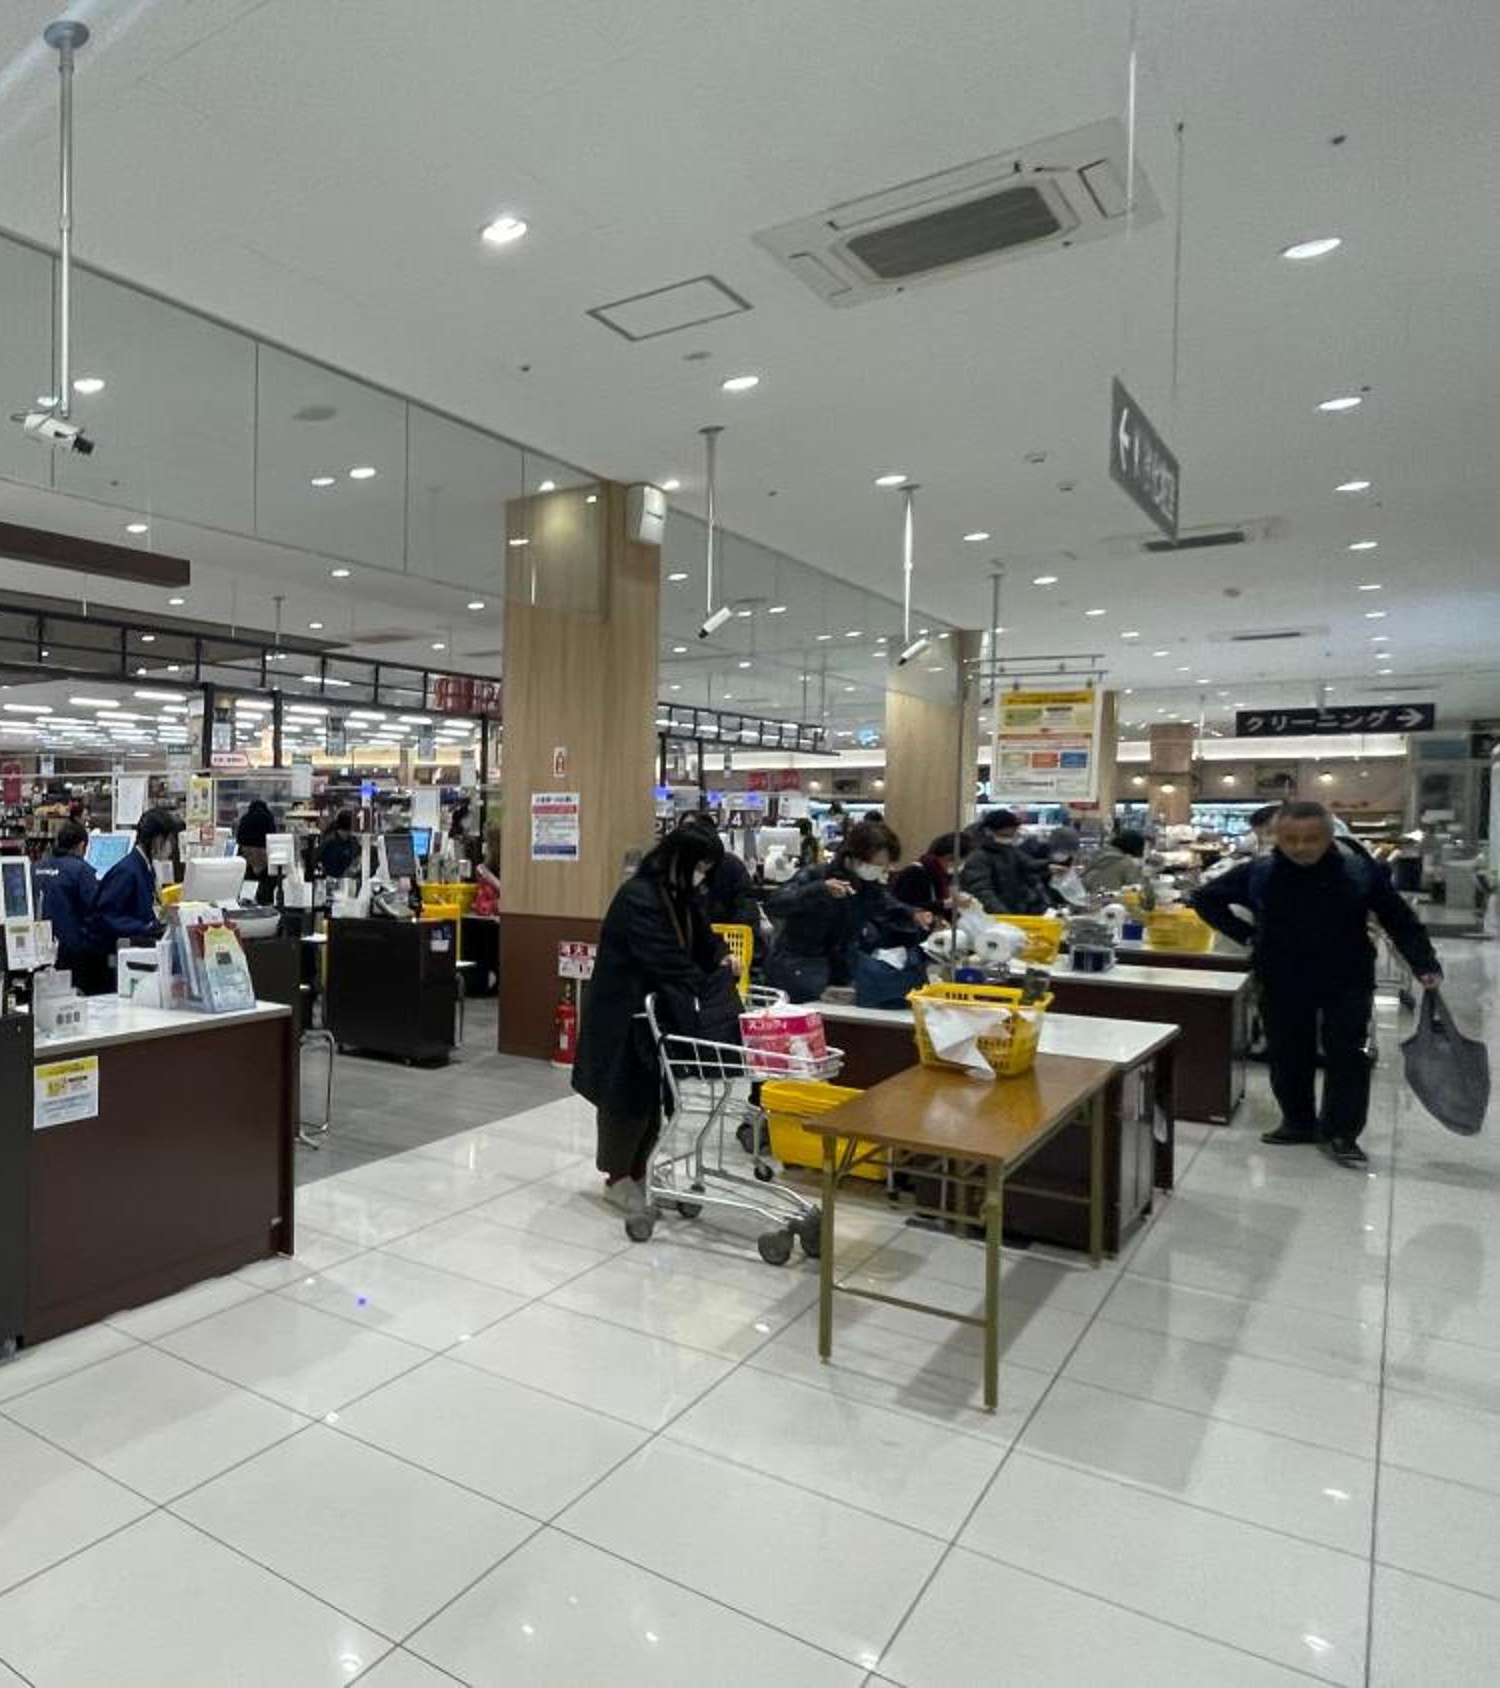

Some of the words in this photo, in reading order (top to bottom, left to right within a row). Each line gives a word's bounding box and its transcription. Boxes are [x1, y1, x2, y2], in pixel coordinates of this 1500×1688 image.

[1246, 709, 1390, 732] クリーニング
